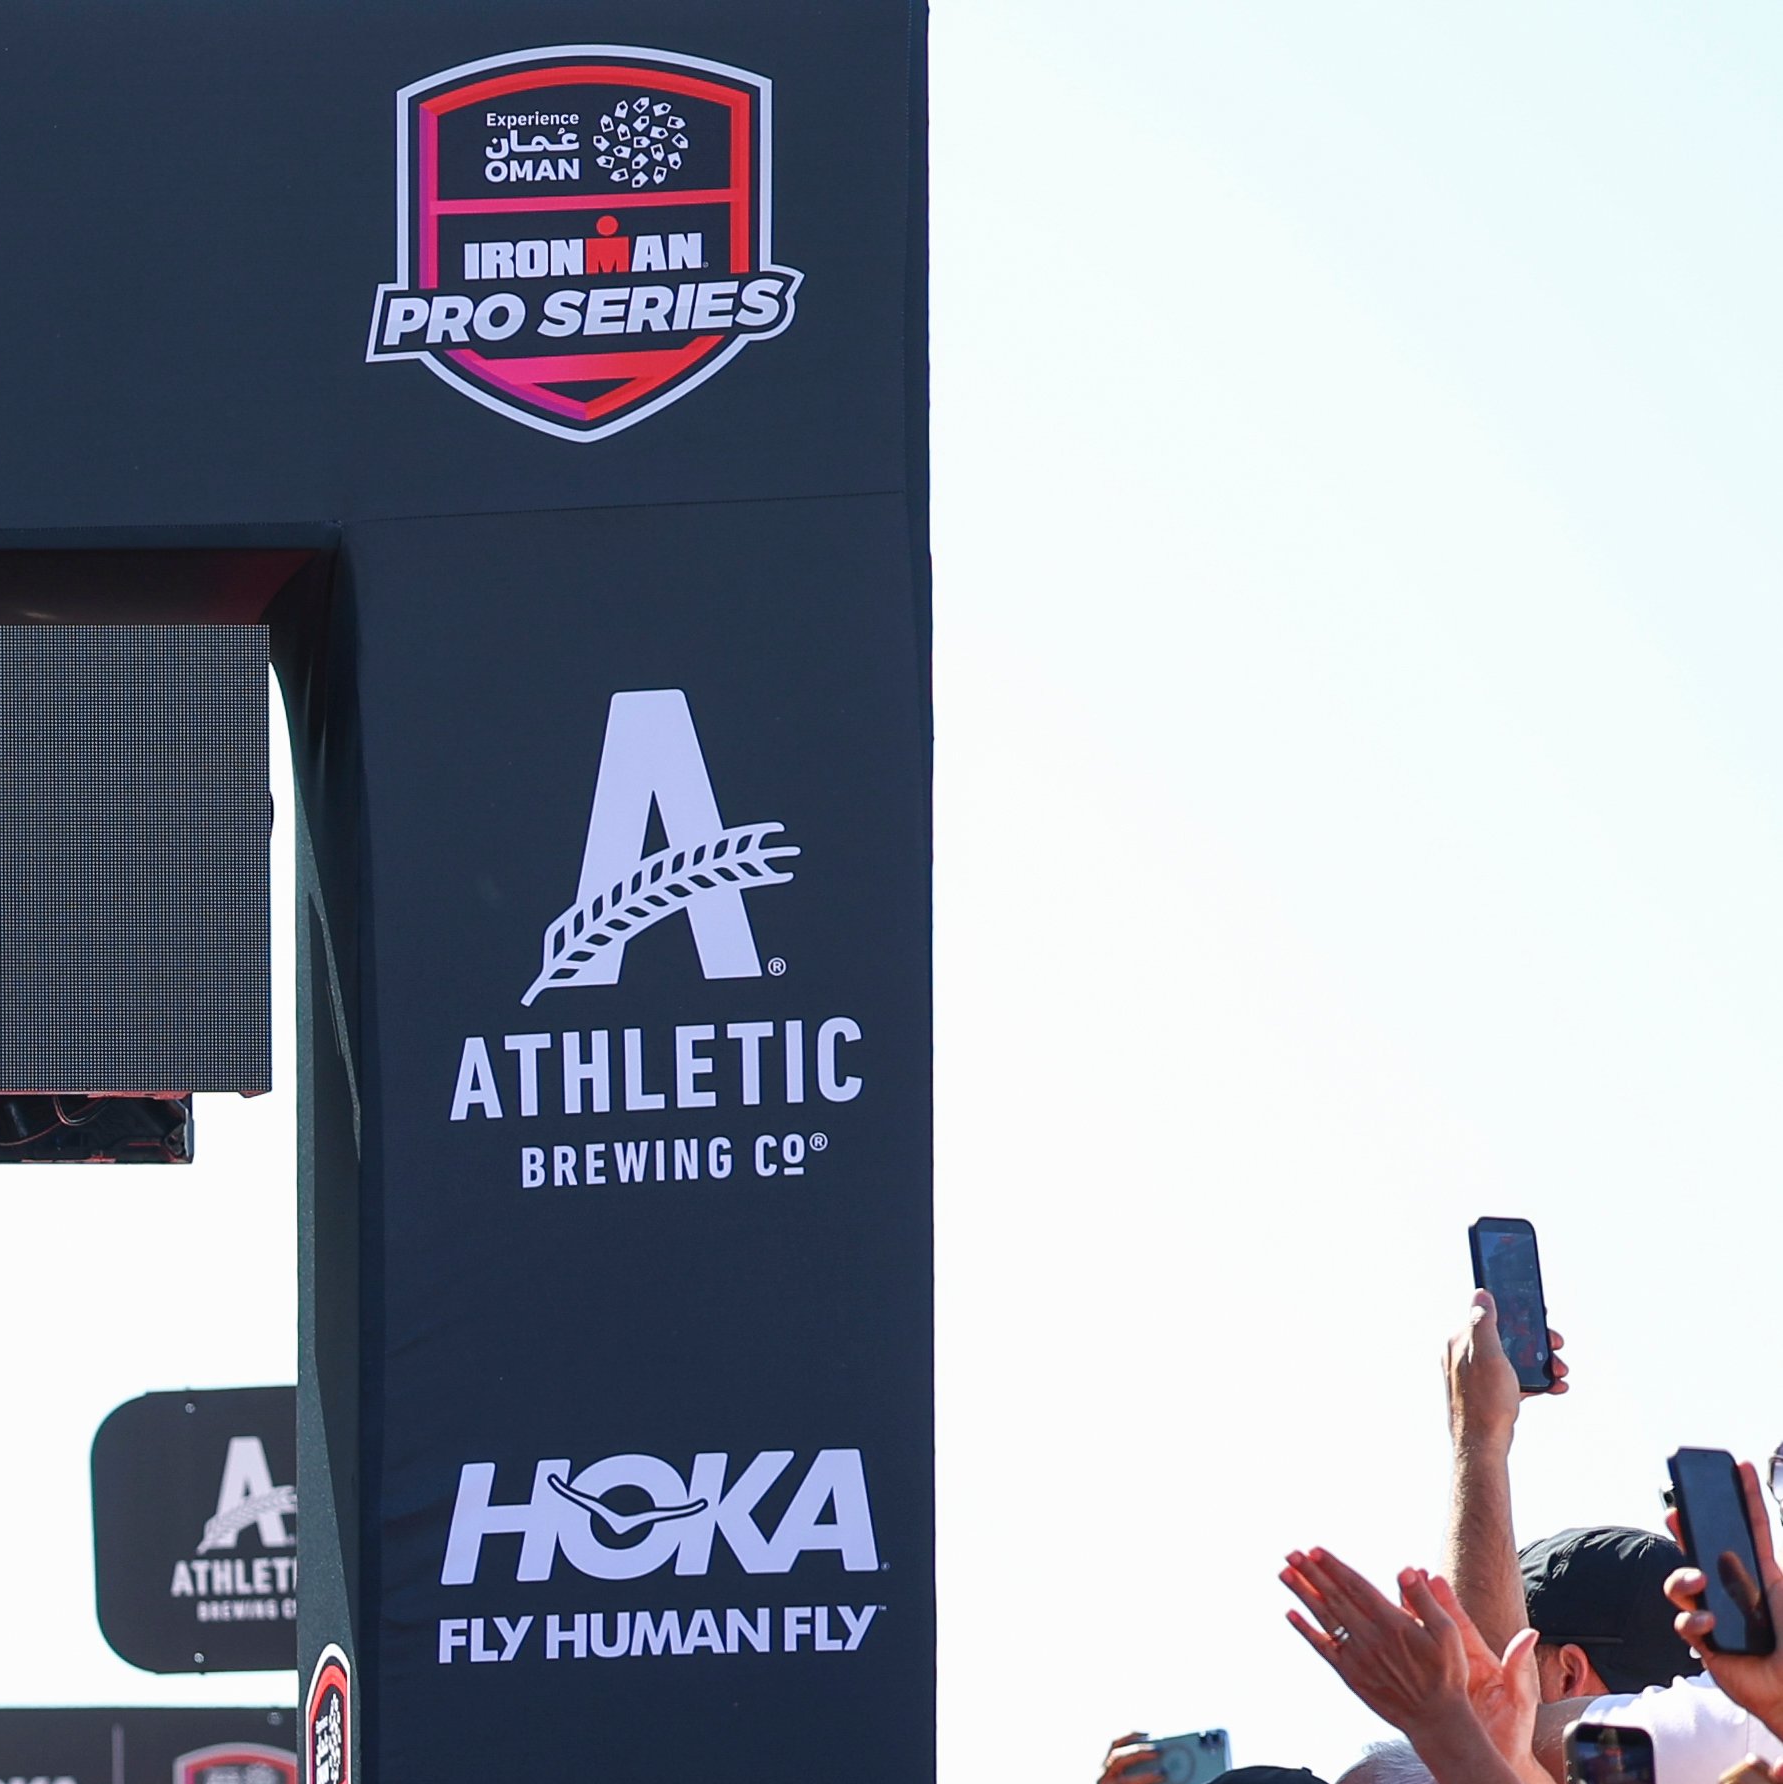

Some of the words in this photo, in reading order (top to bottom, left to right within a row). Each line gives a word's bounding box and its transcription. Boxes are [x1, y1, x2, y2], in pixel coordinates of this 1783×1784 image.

[486, 111, 579, 128] Experience
[484, 158, 580, 182] OMAN
[464, 233, 702, 280] IRONMAN
[383, 292, 526, 346] PRO
[537, 278, 784, 338] SERIES
[449, 1016, 863, 1121] ATHLETIC
[521, 1136, 732, 1189] BREWING
[440, 1448, 879, 1585] HOKA
[438, 1615, 534, 1664] FLY
[545, 1607, 771, 1660] HUMAN
[783, 1605, 877, 1652] FLY
